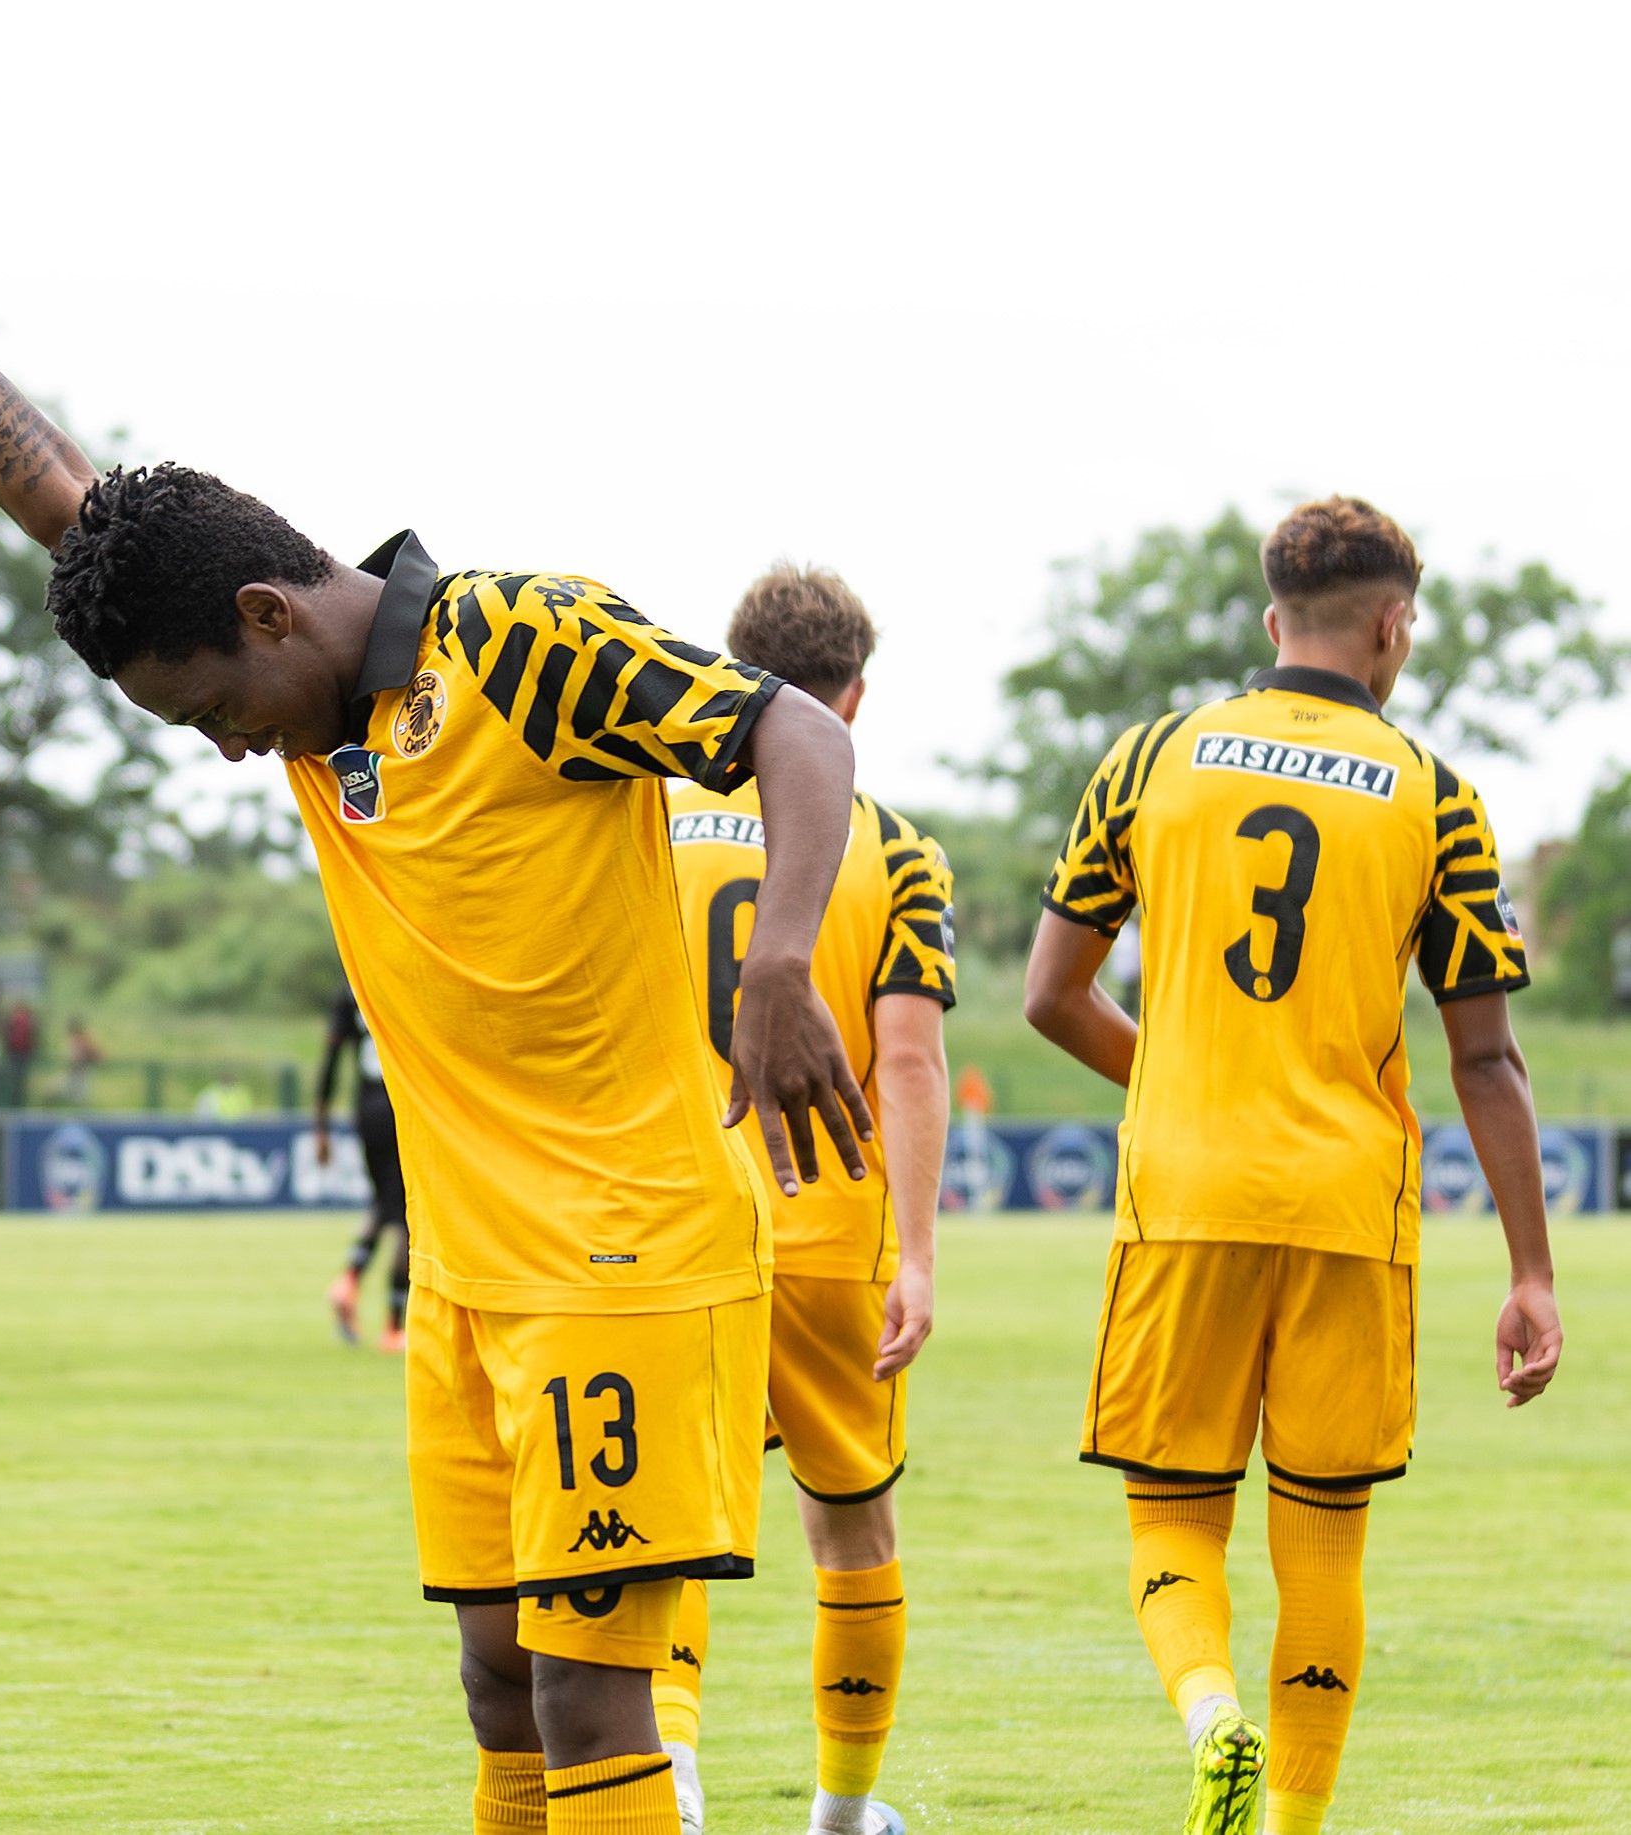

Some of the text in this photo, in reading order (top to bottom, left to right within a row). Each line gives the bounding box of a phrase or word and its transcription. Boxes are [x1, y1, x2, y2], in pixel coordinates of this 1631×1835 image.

[1199, 736, 1390, 793] #ASIDLALI
[1224, 803, 1321, 1003] 3
[119, 1134, 283, 1204] DStv
[542, 1371, 639, 1491] 13
